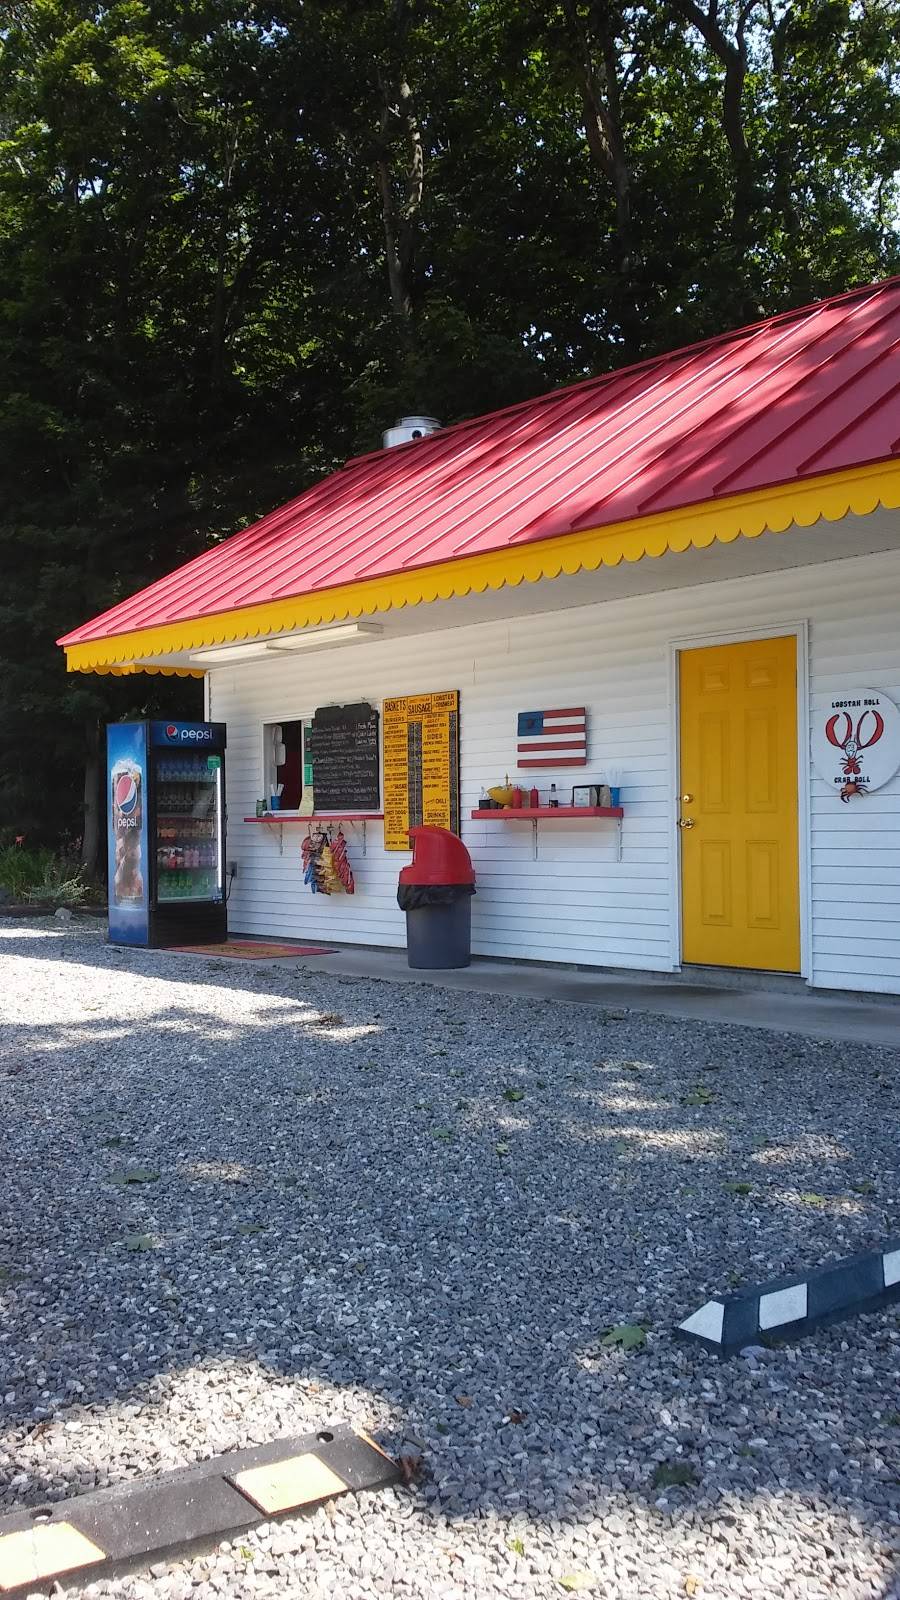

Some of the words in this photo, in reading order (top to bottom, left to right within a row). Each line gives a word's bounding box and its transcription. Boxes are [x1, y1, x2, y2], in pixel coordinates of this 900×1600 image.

[384, 700, 406, 712] BASKETS
[408, 702, 432, 714] SAUSAGE
[832, 700, 861, 708] LOBSTAH
[180, 728, 213, 742] pepsi
[118, 816, 138, 828] pepsi
